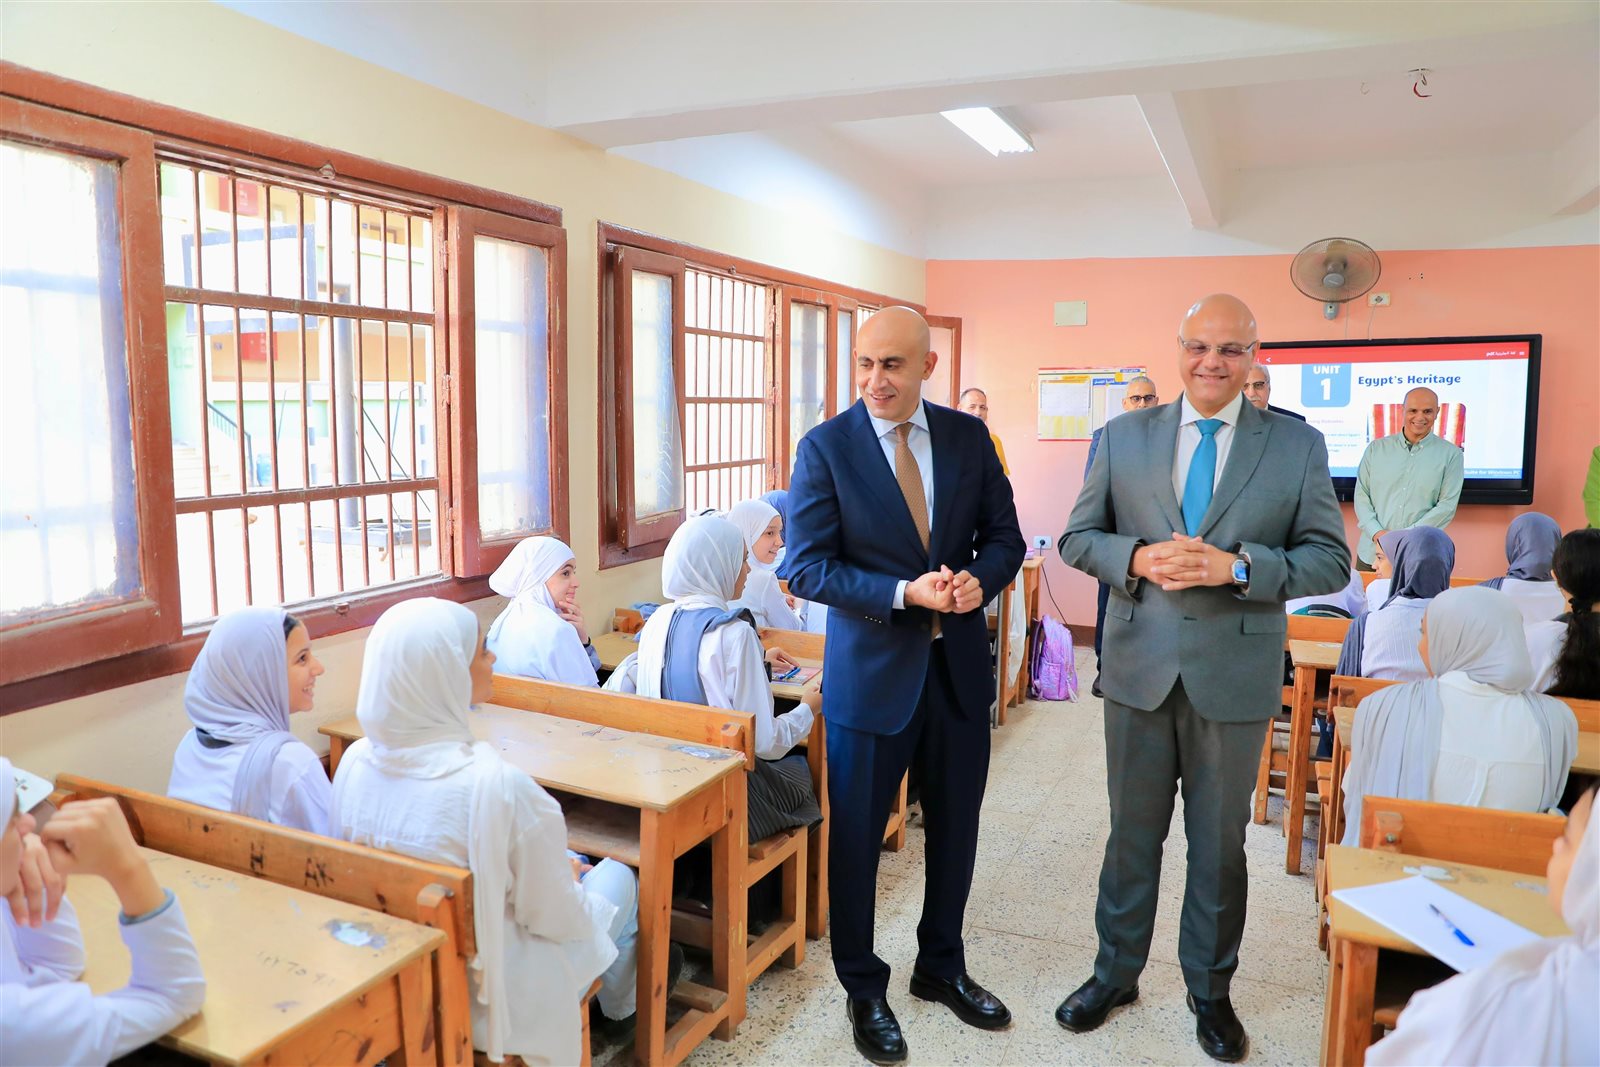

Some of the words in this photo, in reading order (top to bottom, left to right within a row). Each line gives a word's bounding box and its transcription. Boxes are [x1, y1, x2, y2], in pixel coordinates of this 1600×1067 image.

[1313, 365, 1341, 375] UNIT
[1358, 375, 1403, 387] Egypt's
[1407, 374, 1461, 386] Heritage
[1320, 378, 1331, 401] 1
